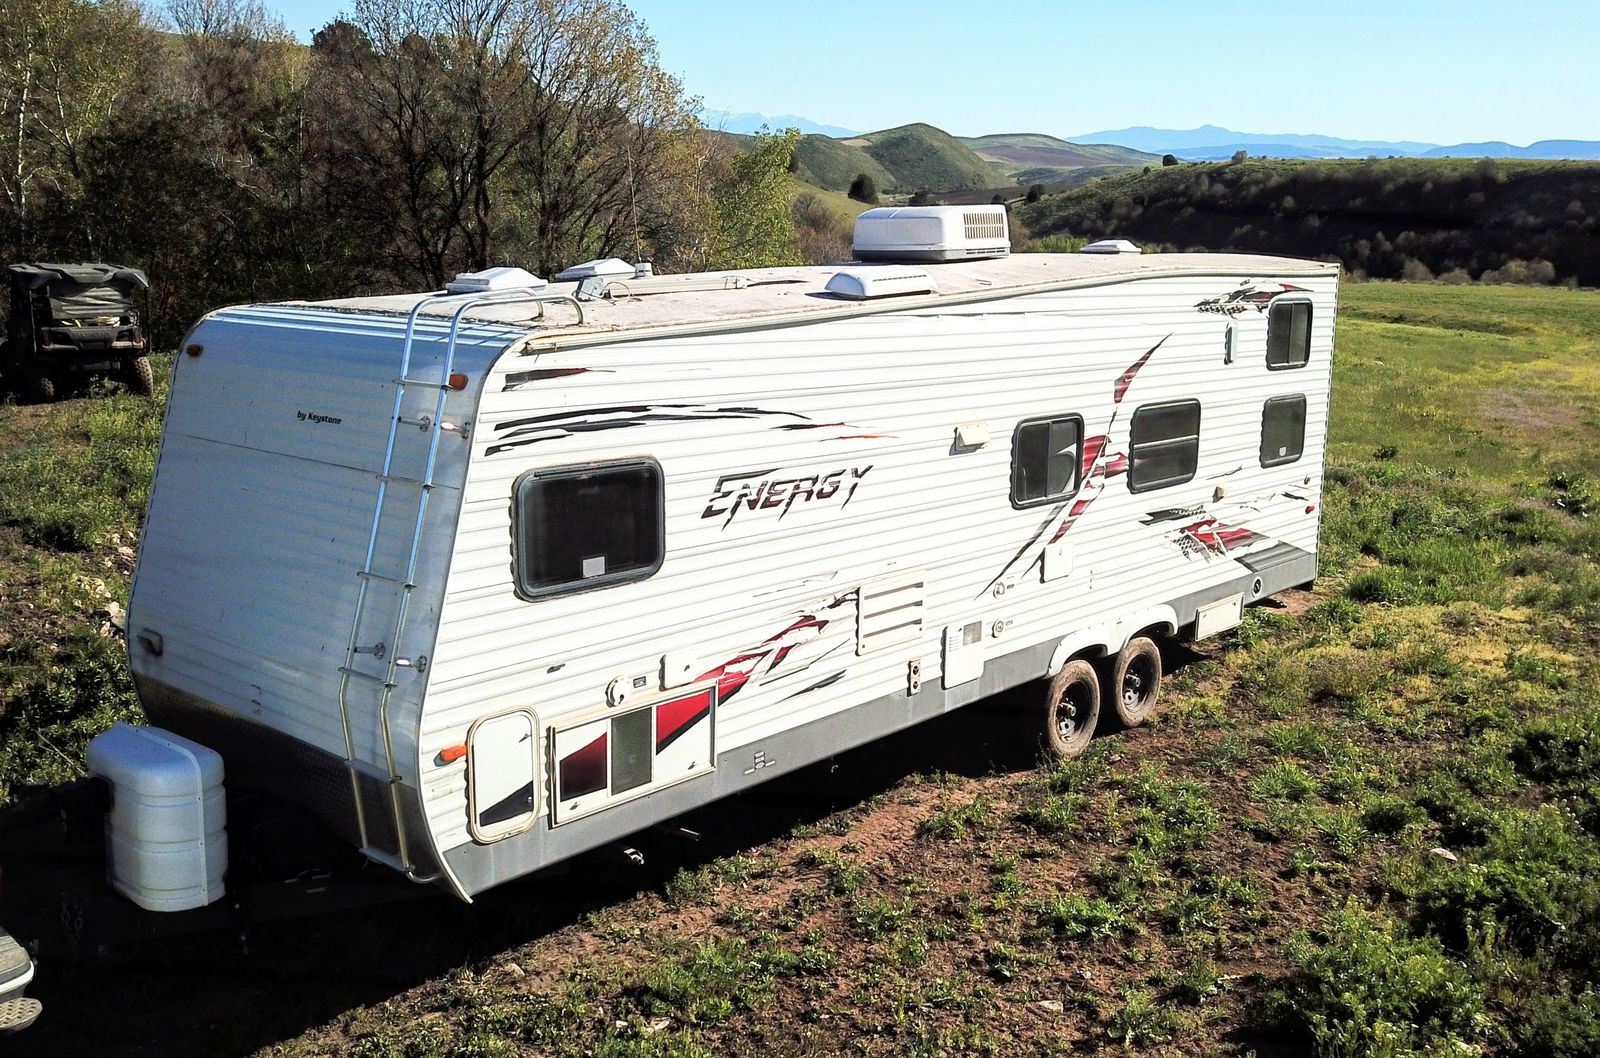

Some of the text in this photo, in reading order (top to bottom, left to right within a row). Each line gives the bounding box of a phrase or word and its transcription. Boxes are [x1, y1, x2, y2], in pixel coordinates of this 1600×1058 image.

[297, 410, 342, 424] by Keystone
[701, 465, 874, 532] ENERGY
